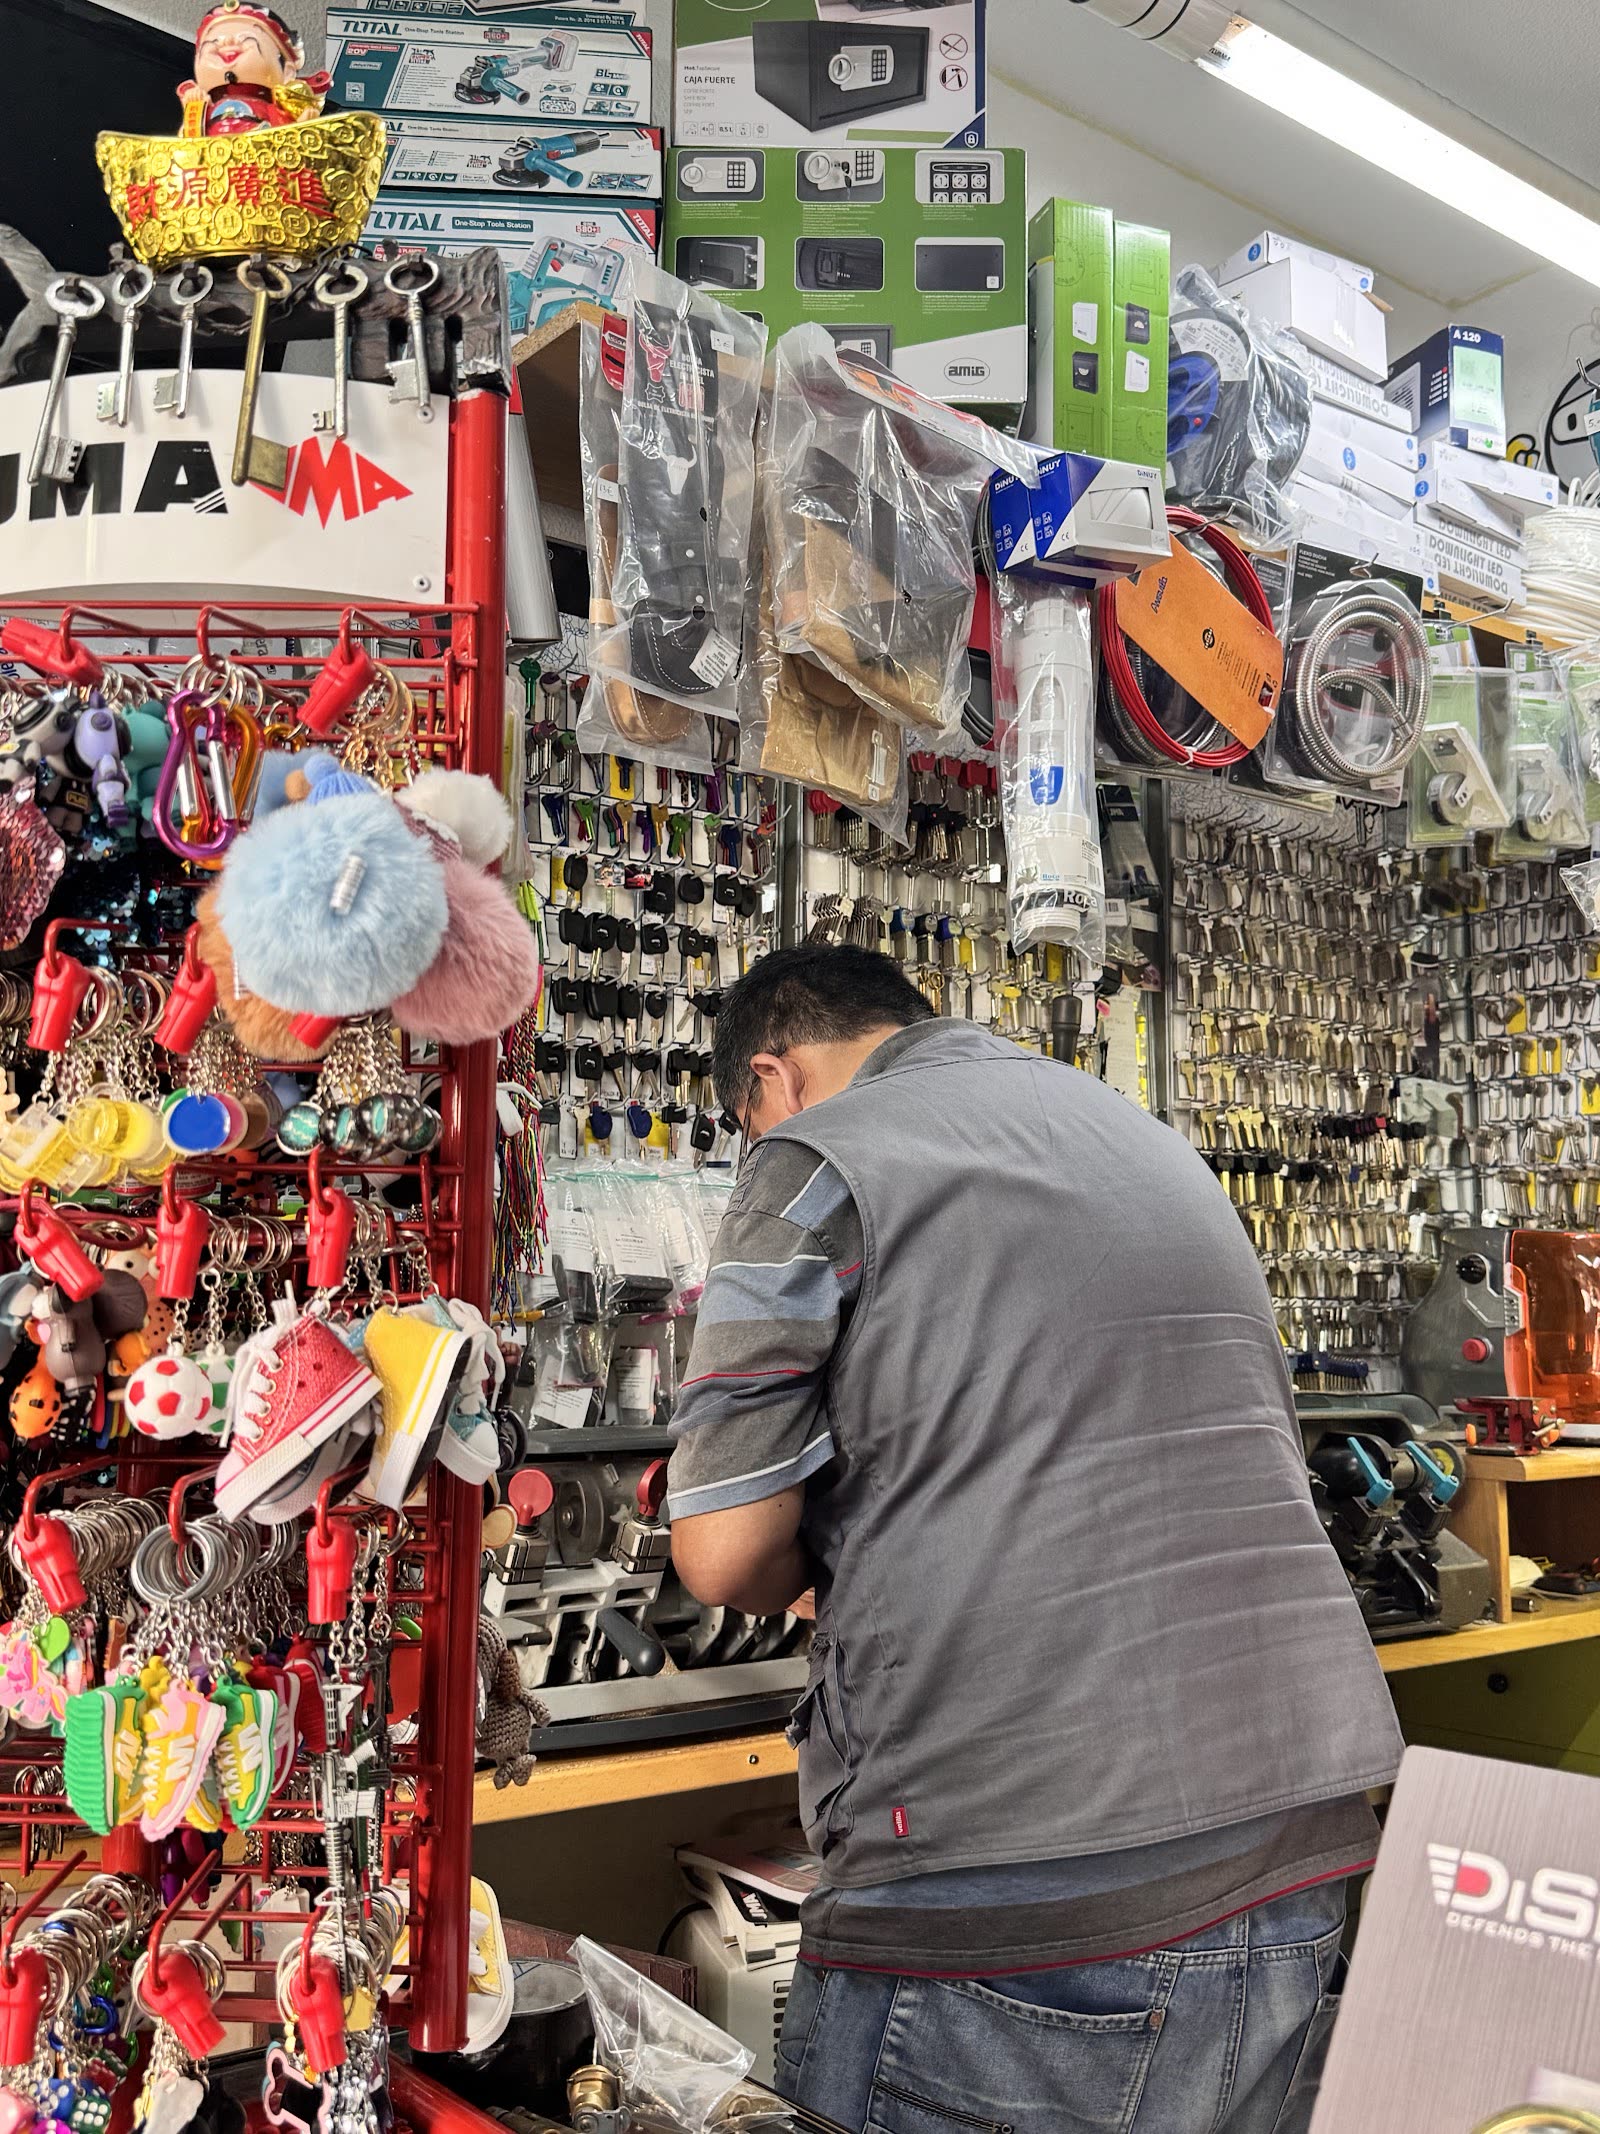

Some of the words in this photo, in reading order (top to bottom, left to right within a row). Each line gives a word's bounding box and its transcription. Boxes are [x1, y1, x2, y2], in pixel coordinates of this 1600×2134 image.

[342, 20, 402, 35] TOTAL
[636, 34, 650, 50] TOTAL
[684, 76, 702, 84] CAJA
[371, 211, 445, 231] OTAL
[455, 220, 486, 228] One-Stop
[633, 213, 654, 239] TOTAL
[1453, 330, 1461, 339] A
[1462, 331, 1481, 343] 120
[1325, 378, 1389, 417] DOWNLIGHT
[0, 440, 228, 525] MA
[1439, 520, 1494, 549] DOWNLIGHT
[1497, 544, 1511, 560] LED
[1429, 535, 1486, 570] DOWNLIGHT
[1488, 560, 1503, 576] LED
[1434, 554, 1450, 570] LED
[1453, 562, 1508, 595] DOWNLIGHT
[1428, 1843, 1600, 1939] DIS
[1446, 1911, 1543, 1947] DEFENDS
[1548, 1936, 1594, 1960] THE
